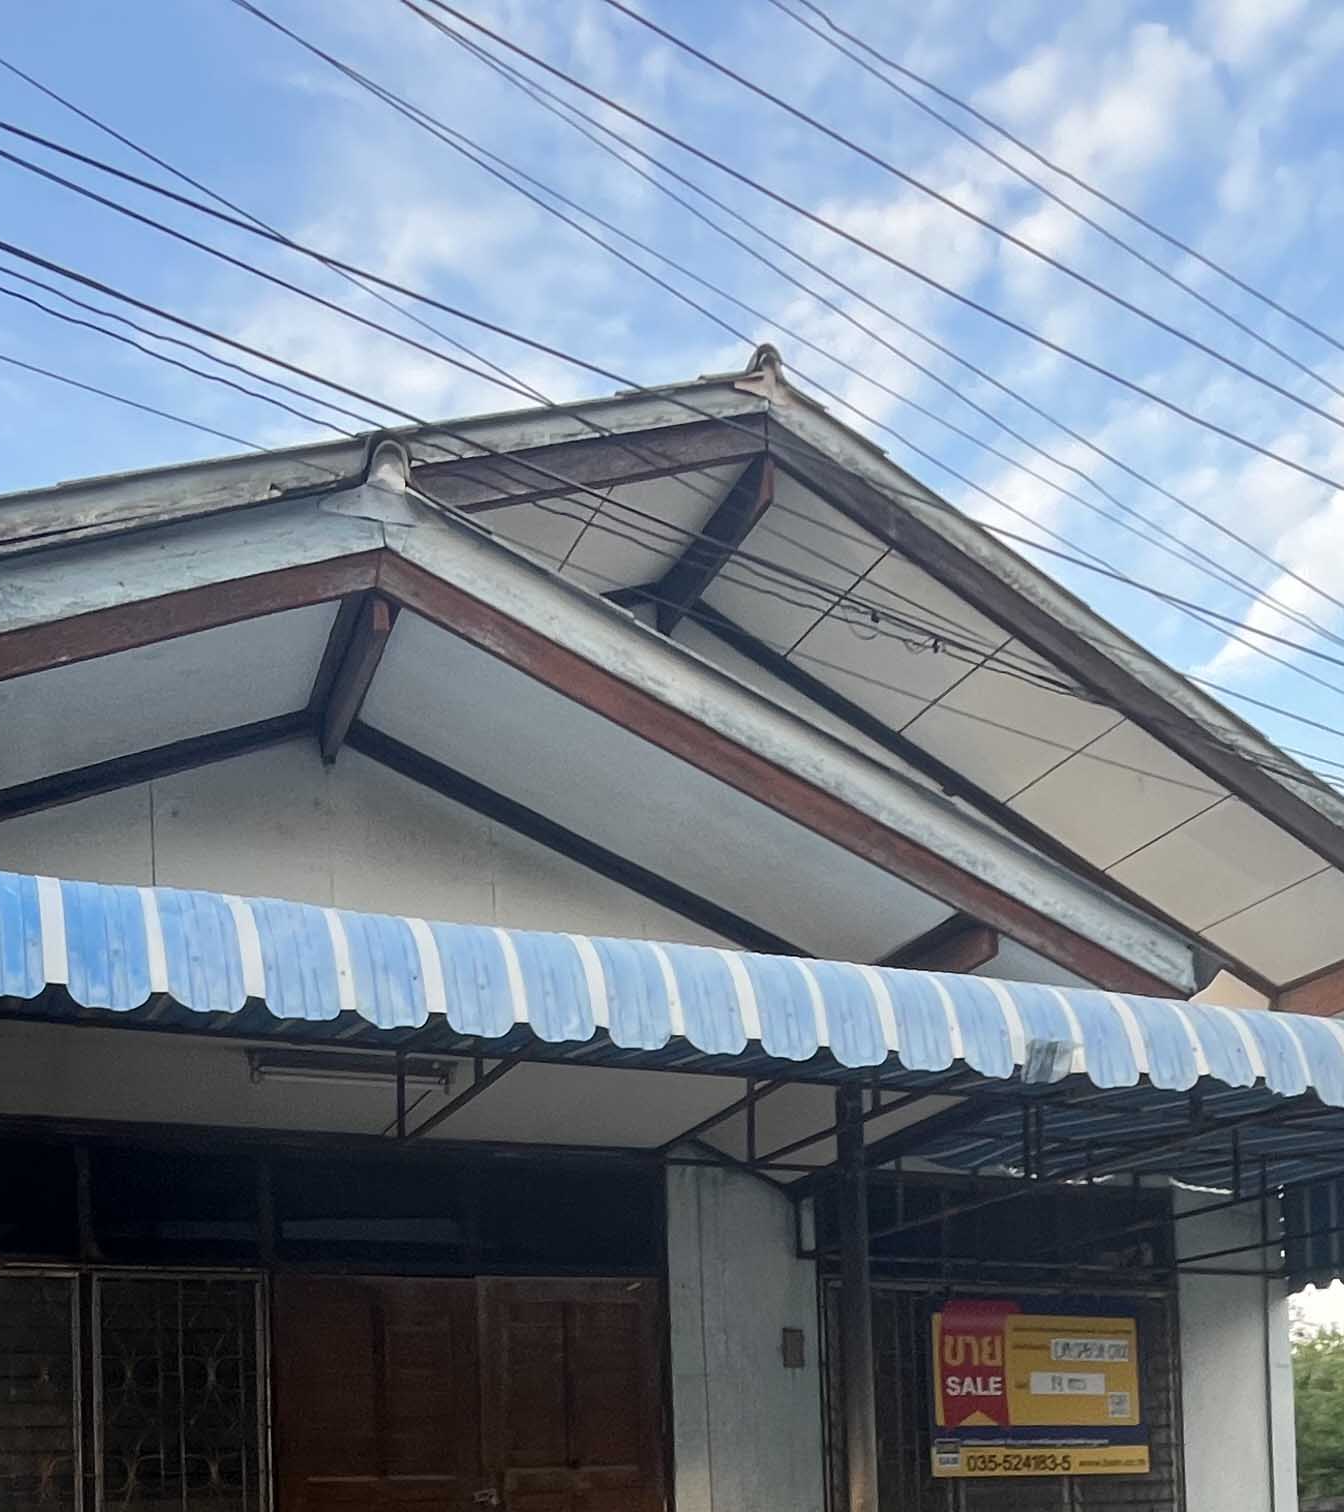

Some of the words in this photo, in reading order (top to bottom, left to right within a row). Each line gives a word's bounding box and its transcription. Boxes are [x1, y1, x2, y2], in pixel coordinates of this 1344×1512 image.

[944, 1335, 1002, 1367] ขาย
[946, 1376, 1003, 1396] SALE
[967, 1454, 1071, 1471] 035-524183-5
